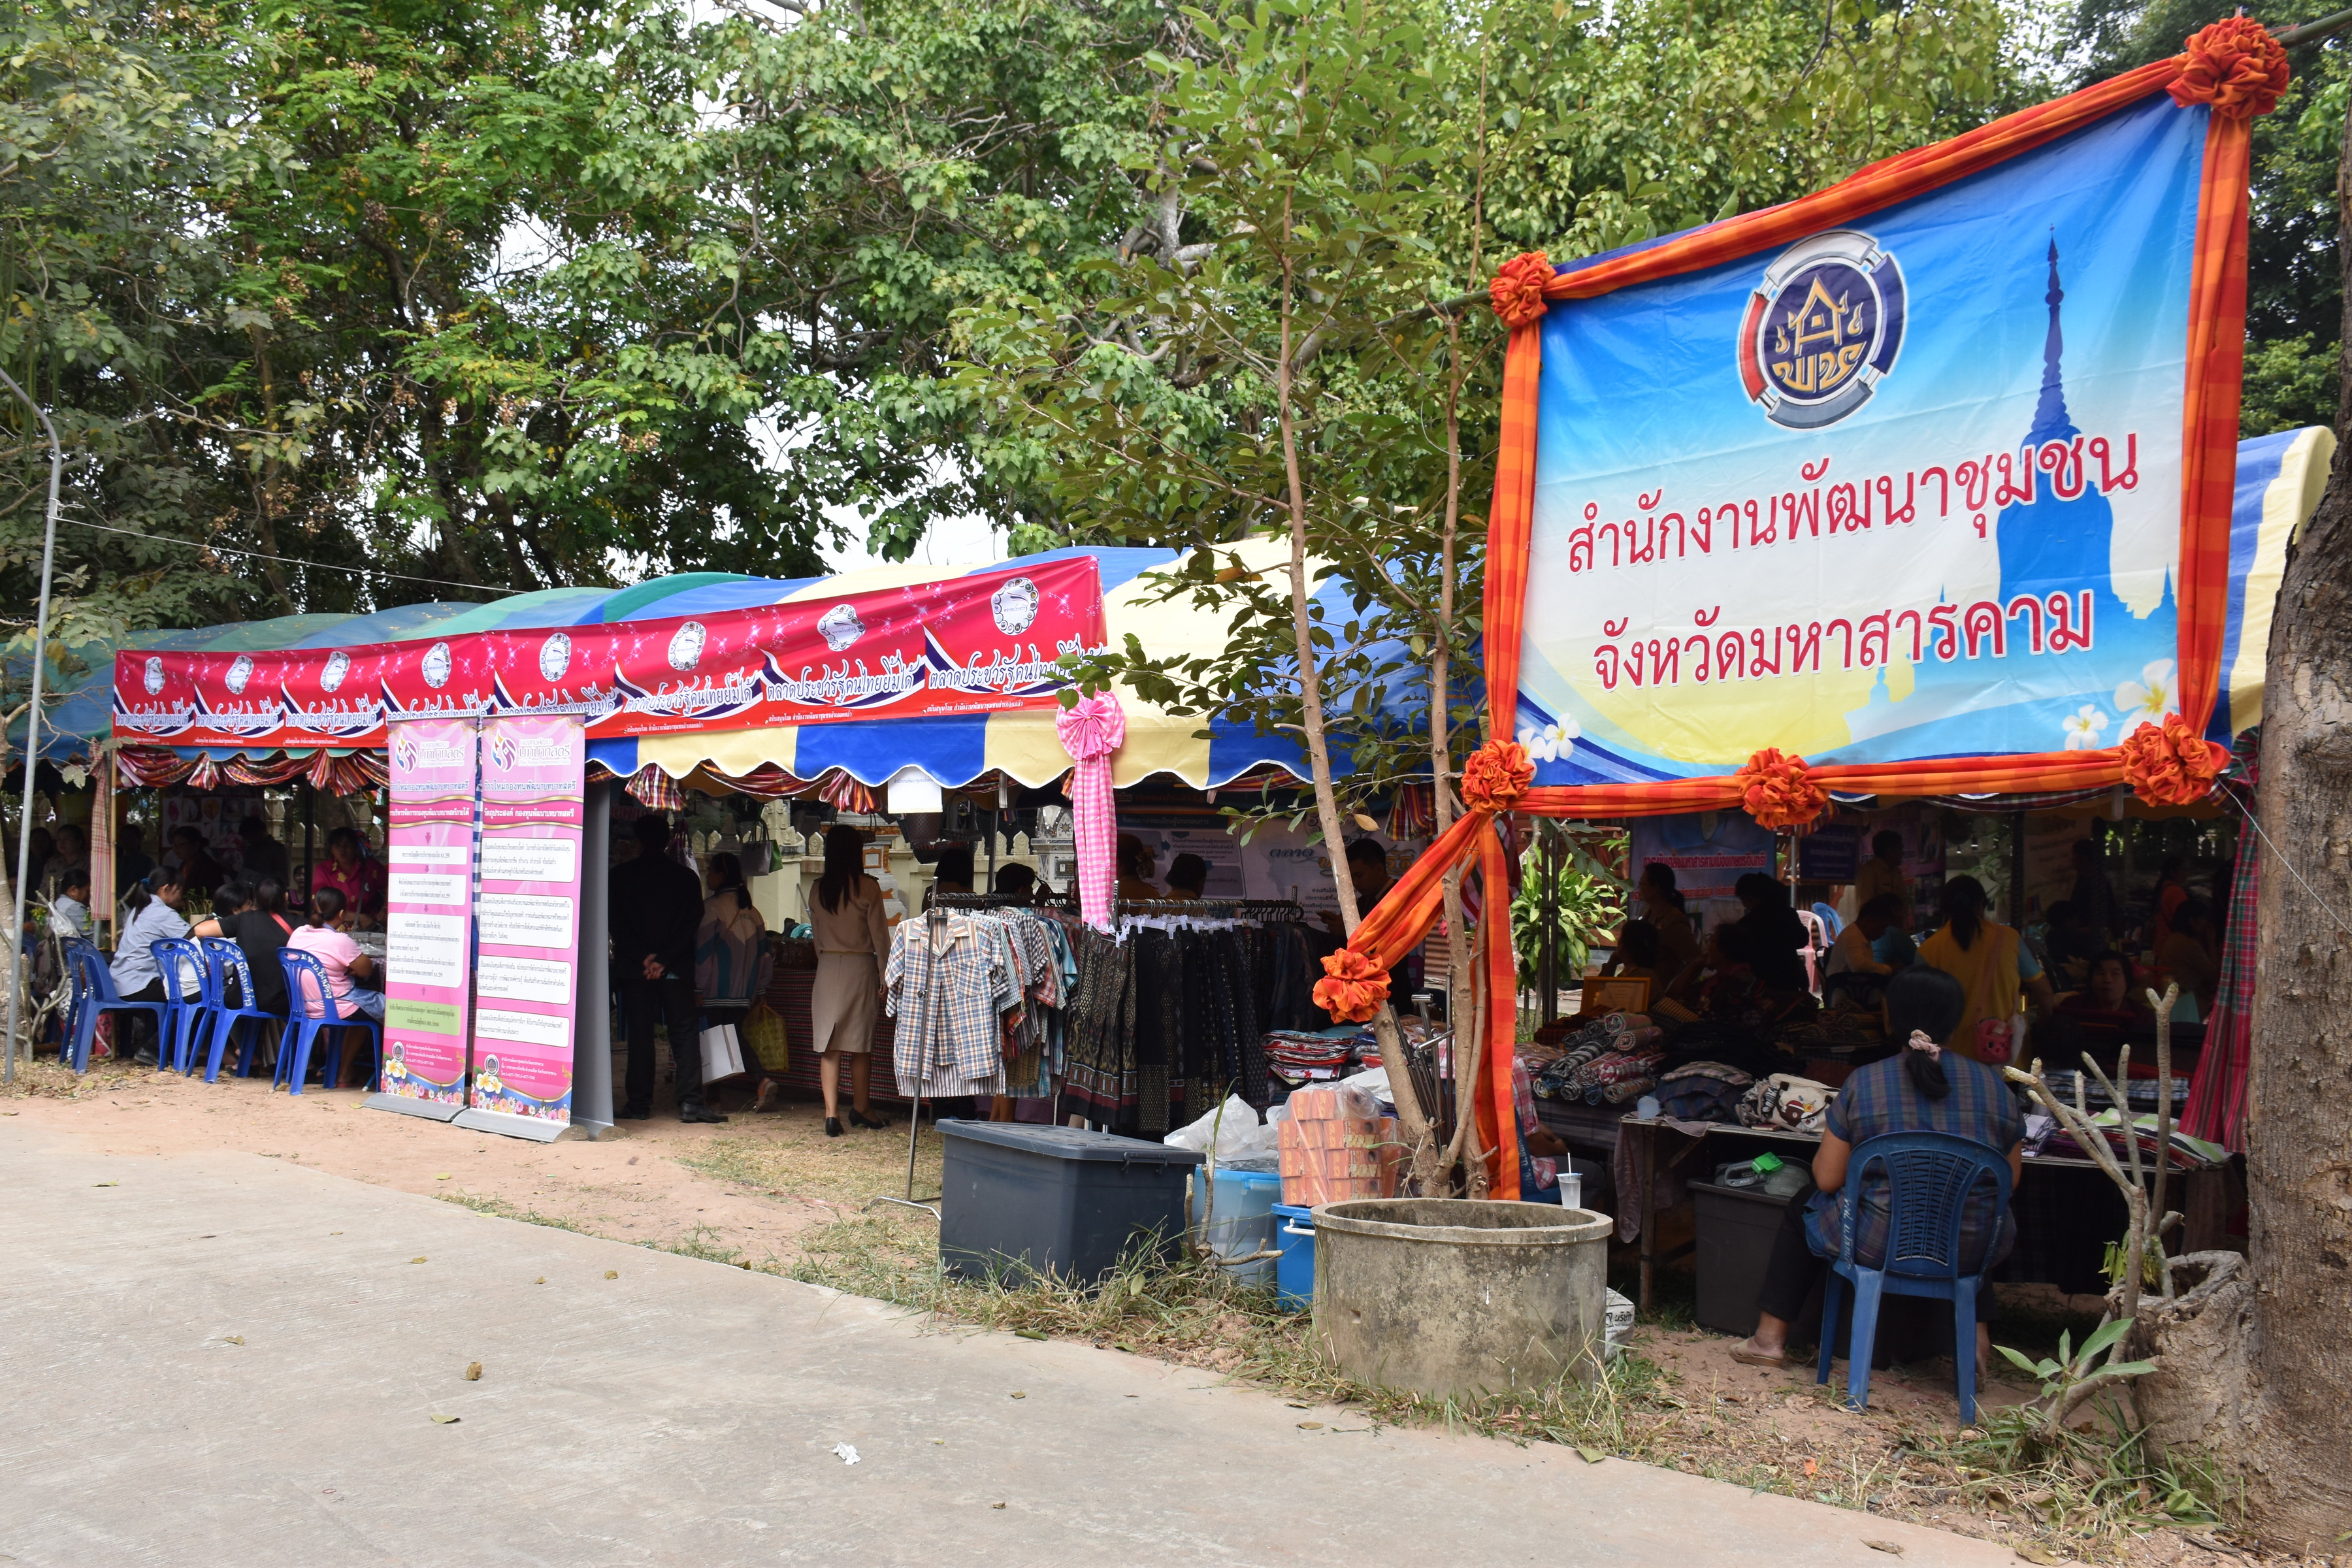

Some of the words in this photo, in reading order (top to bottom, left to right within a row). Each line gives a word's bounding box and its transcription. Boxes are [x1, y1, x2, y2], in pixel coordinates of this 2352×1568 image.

[1568, 433, 2139, 574] สำนักงานพัฒนาชุมชน
[1593, 589, 2092, 691] จังหวัดมหาสารคาม
[767, 649, 921, 705] ตลาดประชารัฐคนไทยยิ้มได้
[419, 746, 465, 759] บทบาทสตรี
[519, 743, 570, 758] บทบาทสตรี
[1269, 849, 1315, 858] ตลาด
